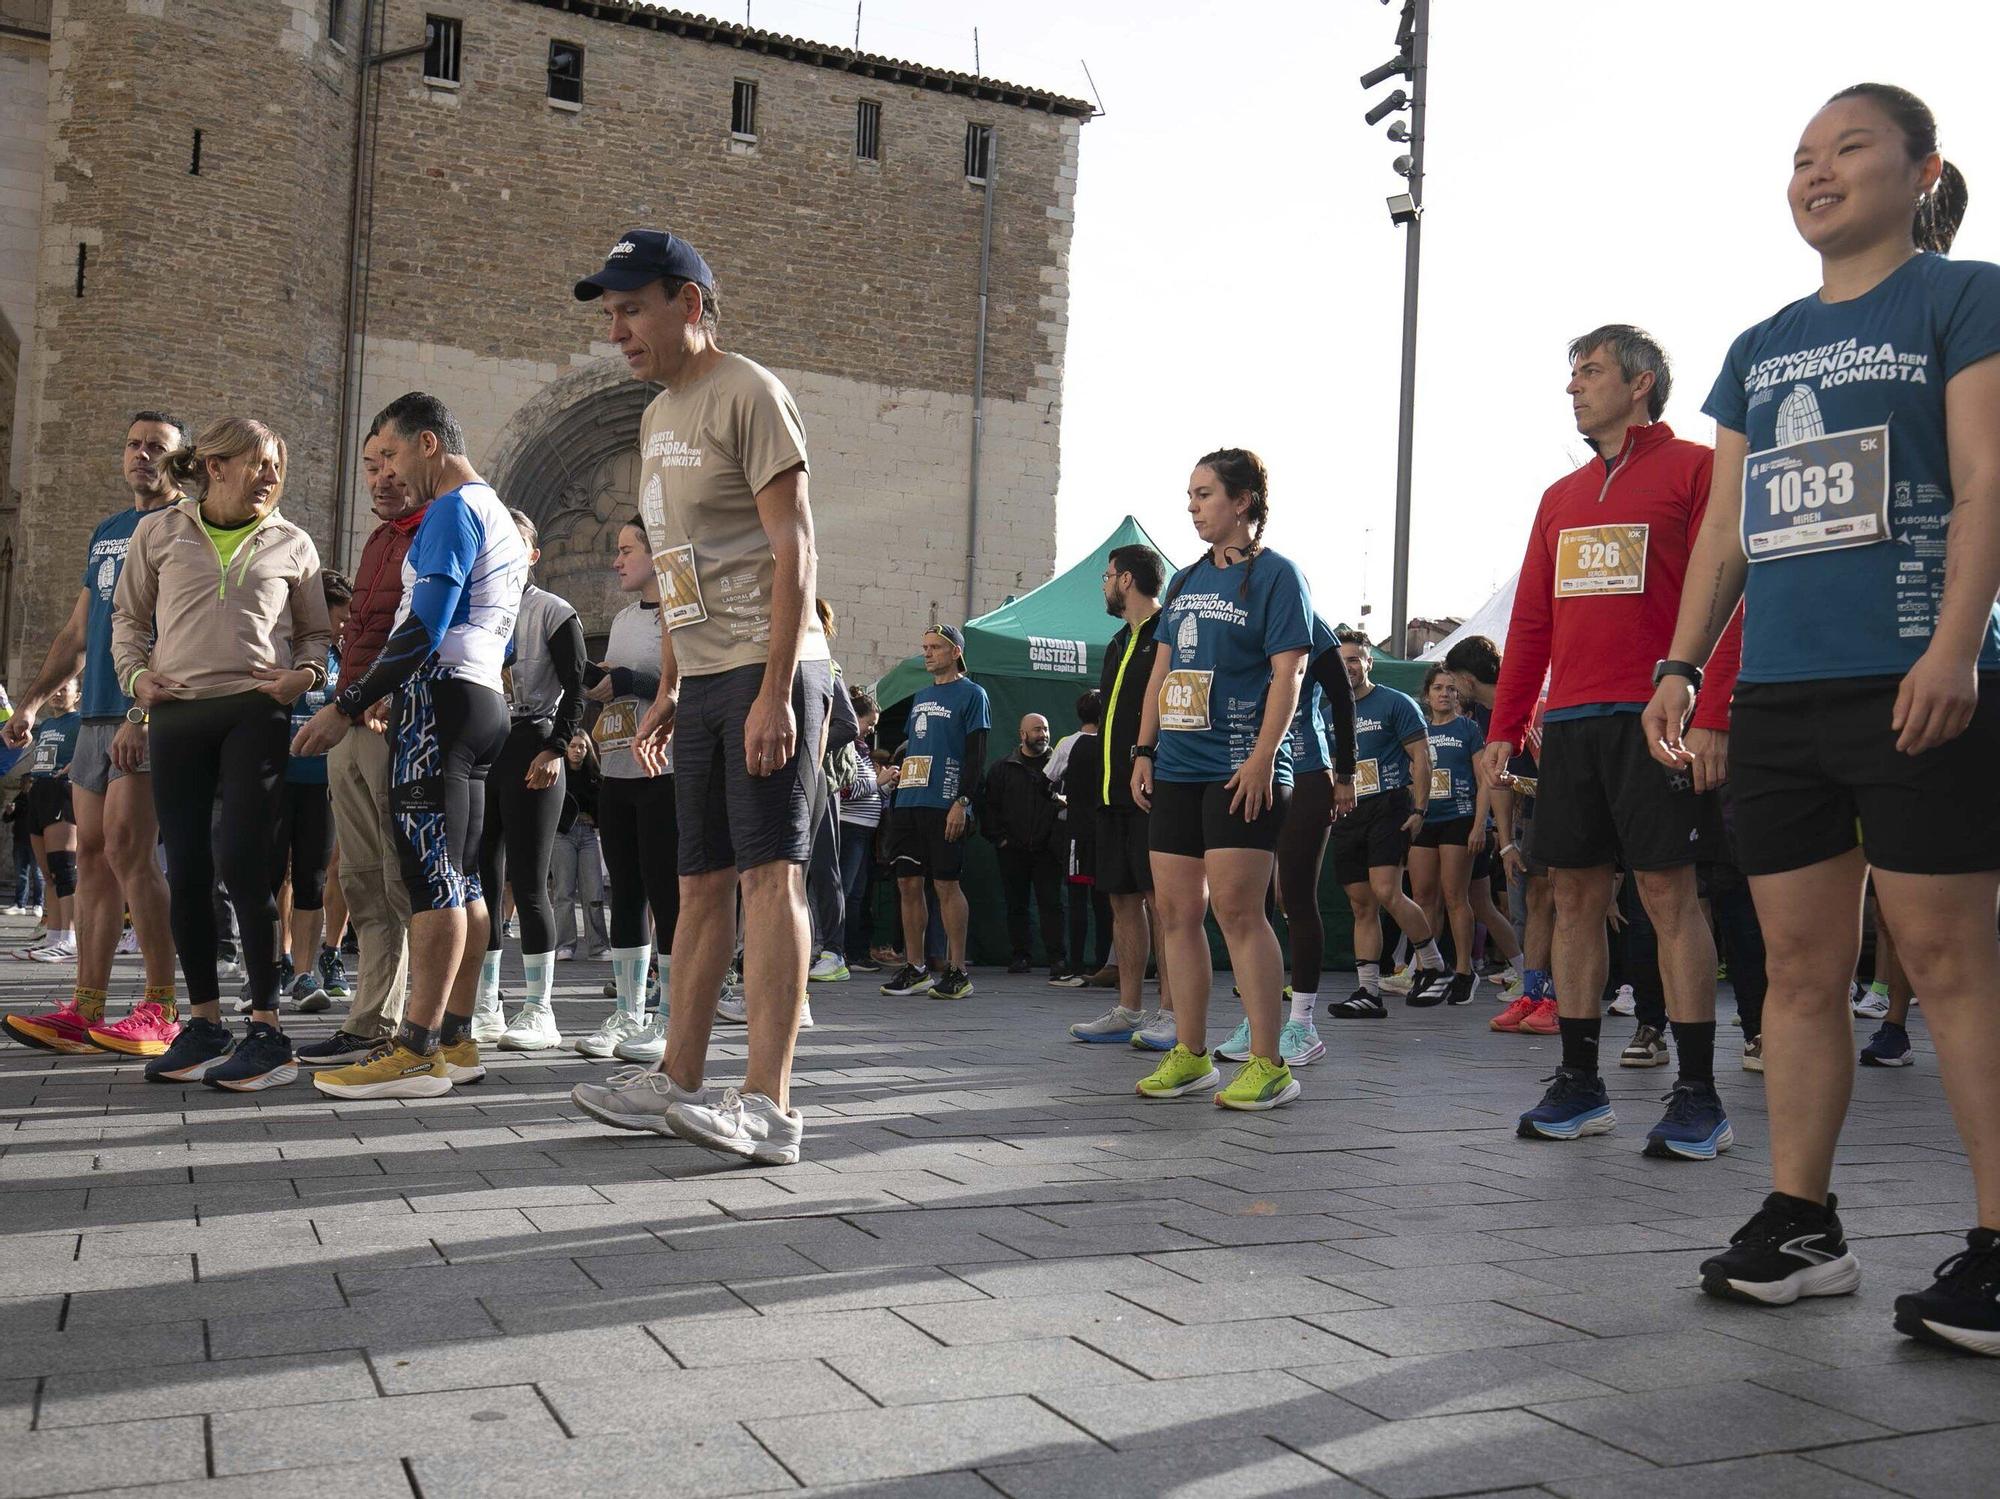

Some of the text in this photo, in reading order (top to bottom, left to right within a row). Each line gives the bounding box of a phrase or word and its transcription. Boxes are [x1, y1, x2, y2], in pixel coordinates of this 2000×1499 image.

[1758, 337, 1857, 374] CONQUISTA
[1755, 343, 1897, 392] ALMENDRA
[1897, 352, 1928, 367] REN
[1820, 364, 1928, 390] KONKISTA
[1859, 438, 1879, 452] 5K
[662, 455, 702, 467] KONKISTA
[1765, 461, 1855, 516] 1033
[1793, 511, 1822, 525] MIREN
[1894, 515, 1940, 525] LABORAL
[1627, 531, 1642, 539] 10K
[677, 553, 689, 563] 10K
[1577, 542, 1620, 570] 326
[1179, 593, 1220, 602] CONQUISTA
[1173, 600, 1234, 613] ALMENDRA
[1198, 610, 1246, 626] KONKISTA
[1027, 636, 1076, 650] VITORIA
[1030, 647, 1076, 664] GASTEIZ
[1033, 662, 1076, 673] green capital
[1165, 685, 1192, 708] 483
[602, 714, 623, 736] 709
[908, 763, 919, 777] 81
